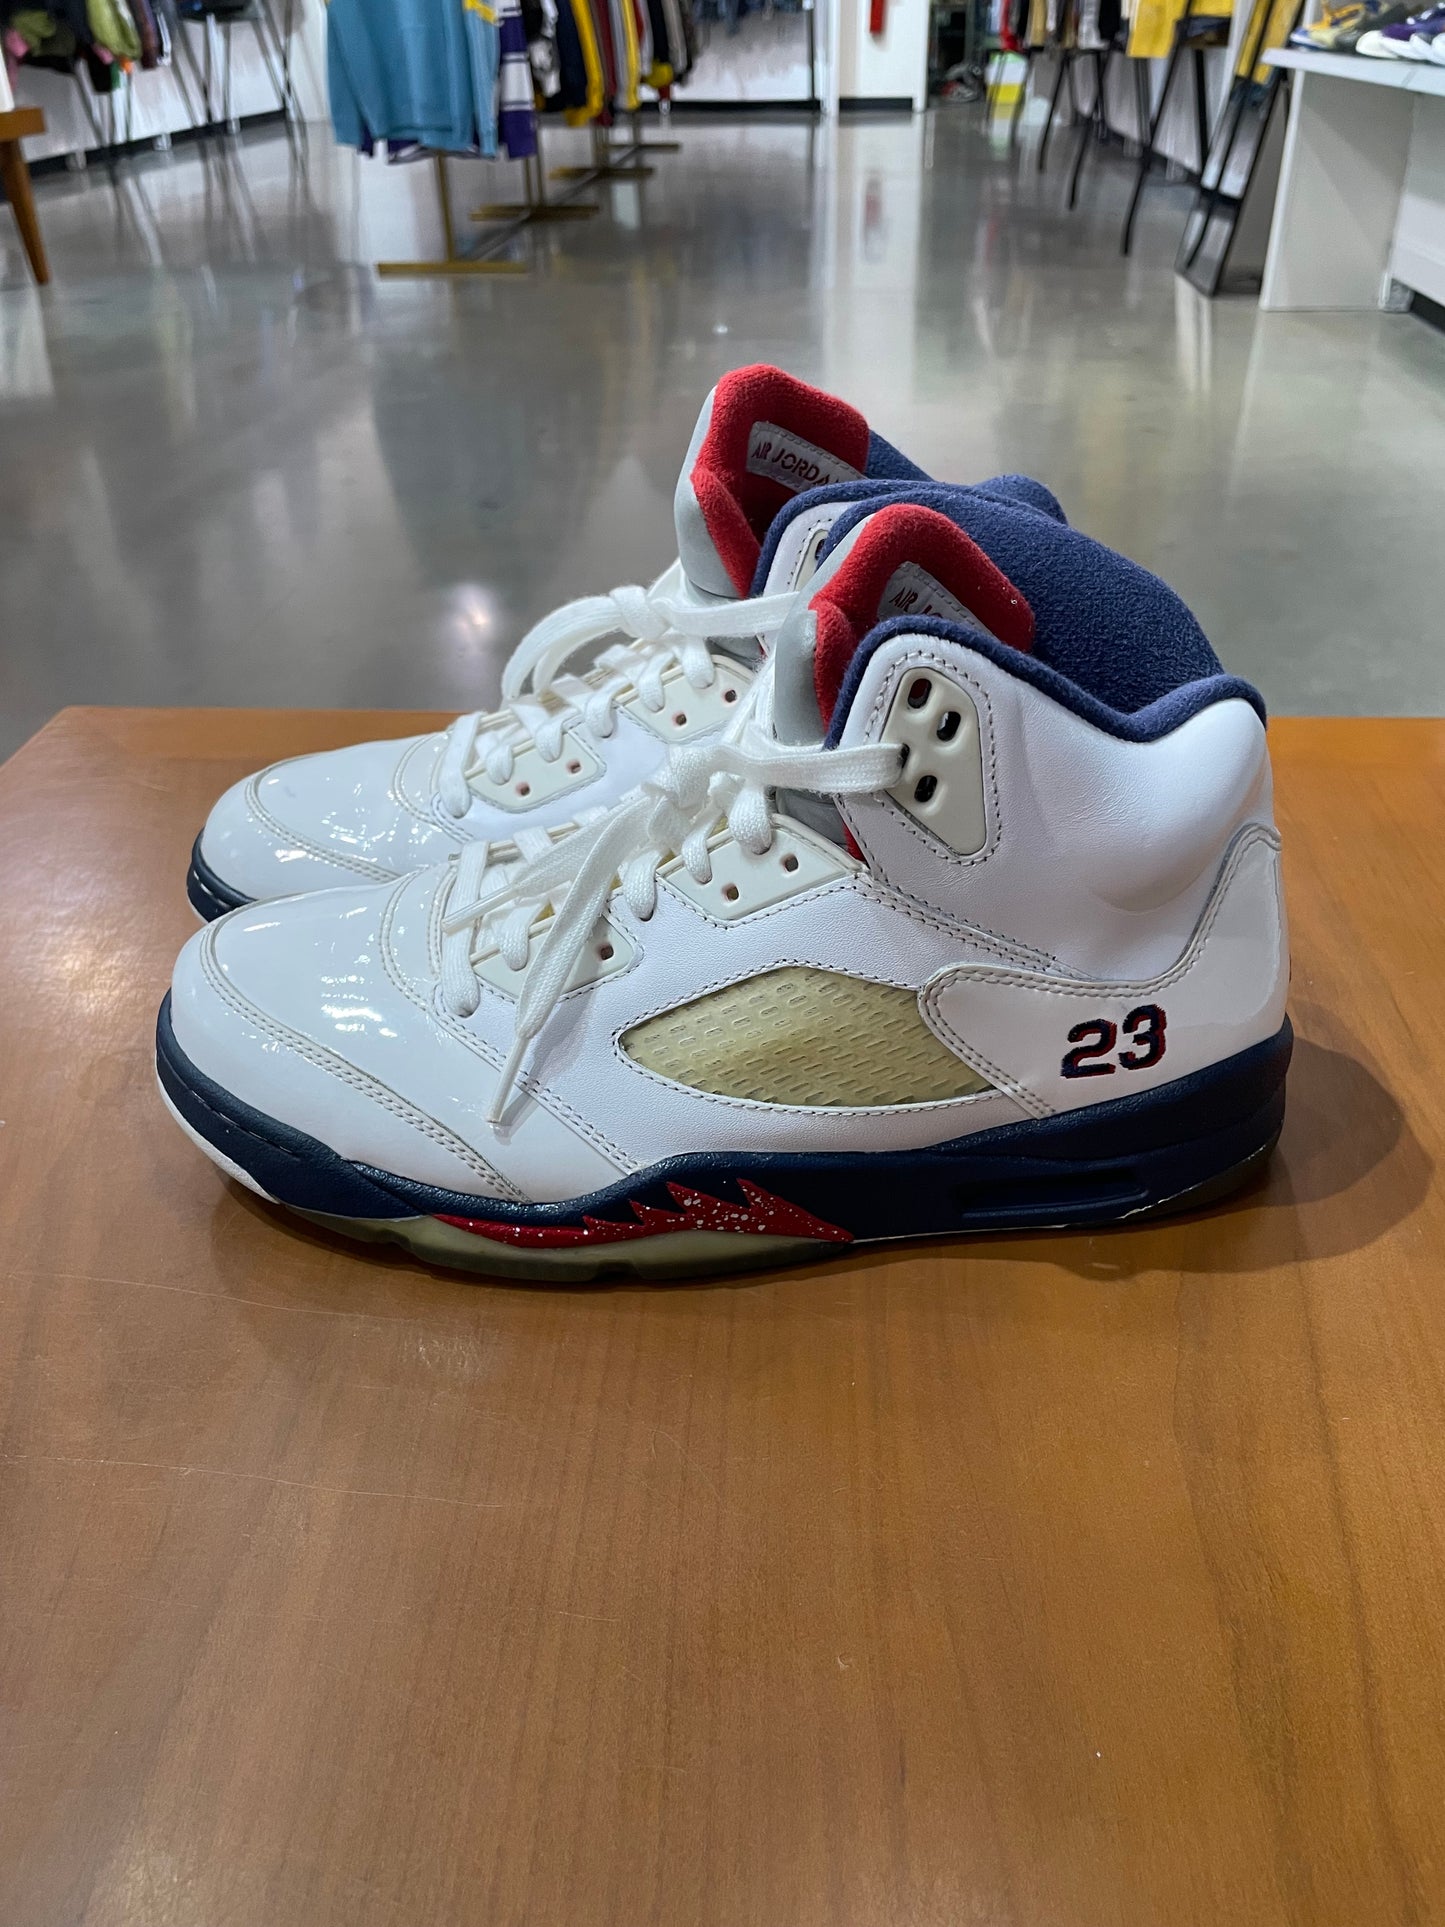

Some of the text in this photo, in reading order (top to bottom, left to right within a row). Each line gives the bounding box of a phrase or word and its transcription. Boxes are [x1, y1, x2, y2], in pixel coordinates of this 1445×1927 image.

[752, 441, 839, 486] AIR JORDA
[889, 586, 918, 612] AIR
[1060, 1004, 1167, 1079] 23
